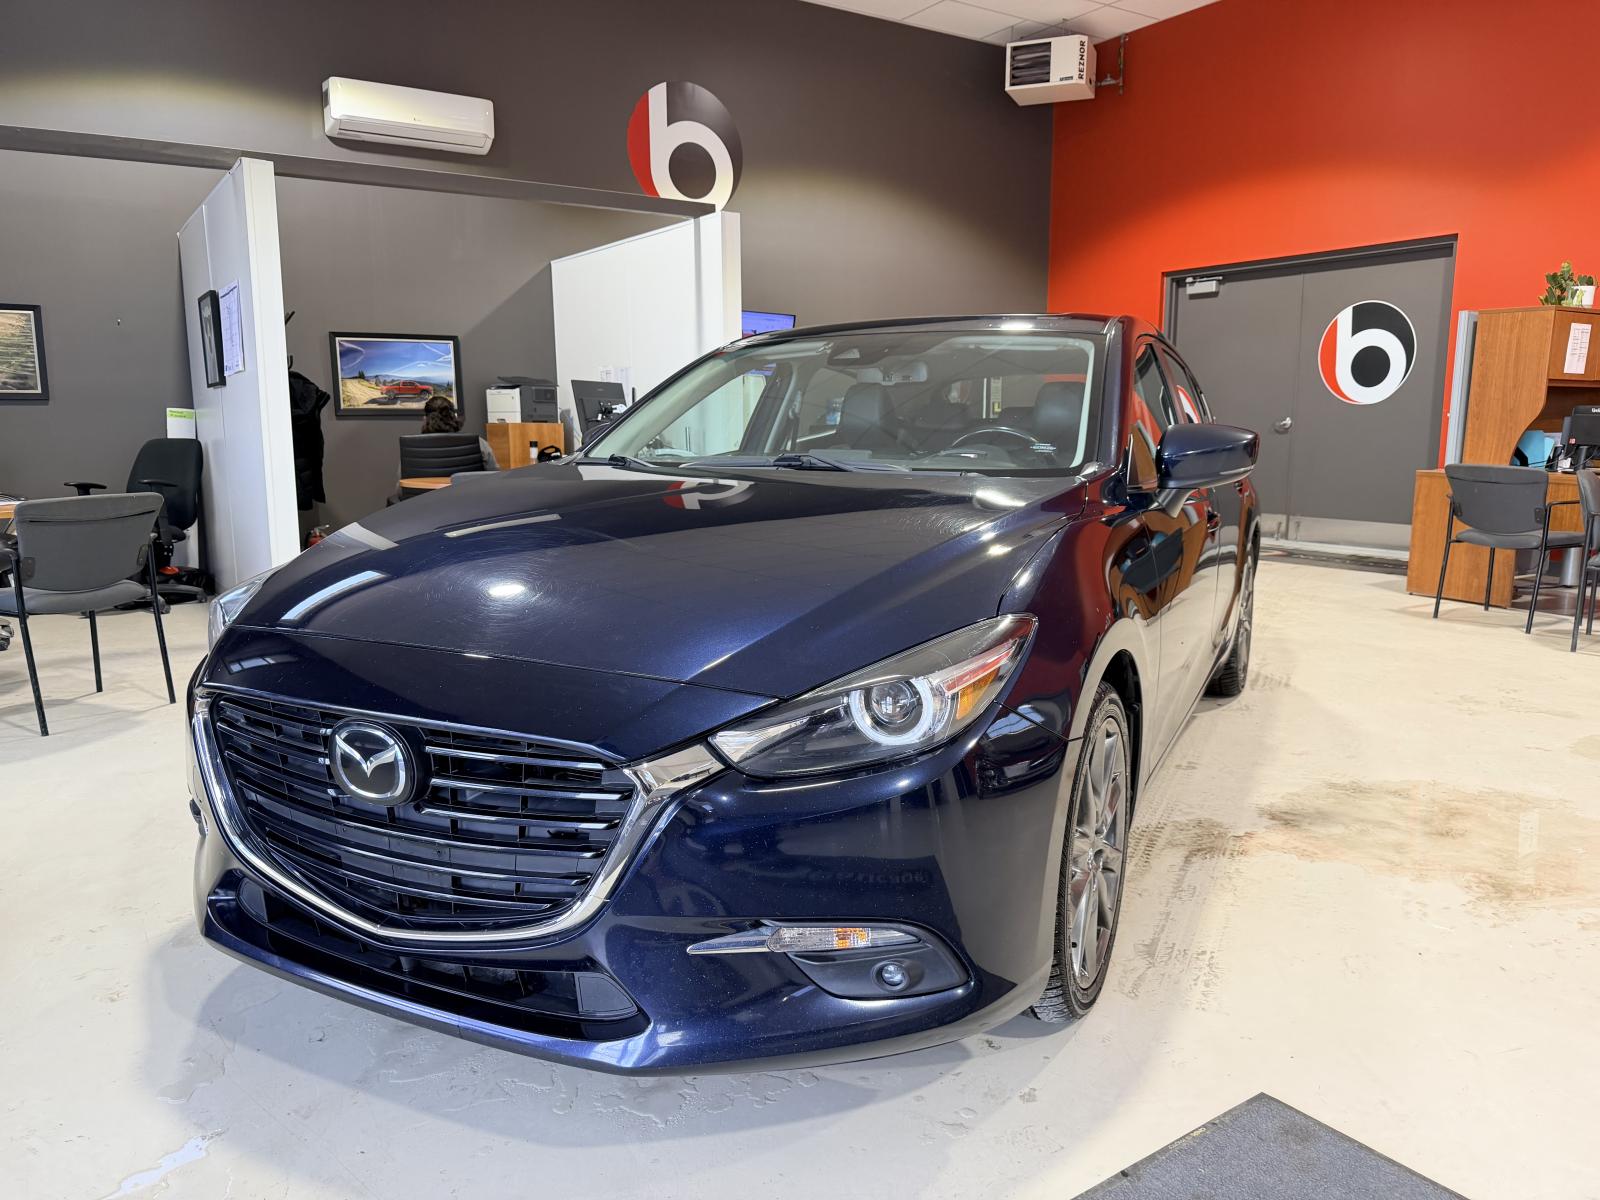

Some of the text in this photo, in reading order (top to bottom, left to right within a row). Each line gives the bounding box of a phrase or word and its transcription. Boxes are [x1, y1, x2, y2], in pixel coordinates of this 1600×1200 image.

[1078, 40, 1086, 80] REZNOR
[648, 81, 734, 211] b
[1335, 302, 1408, 405] b
